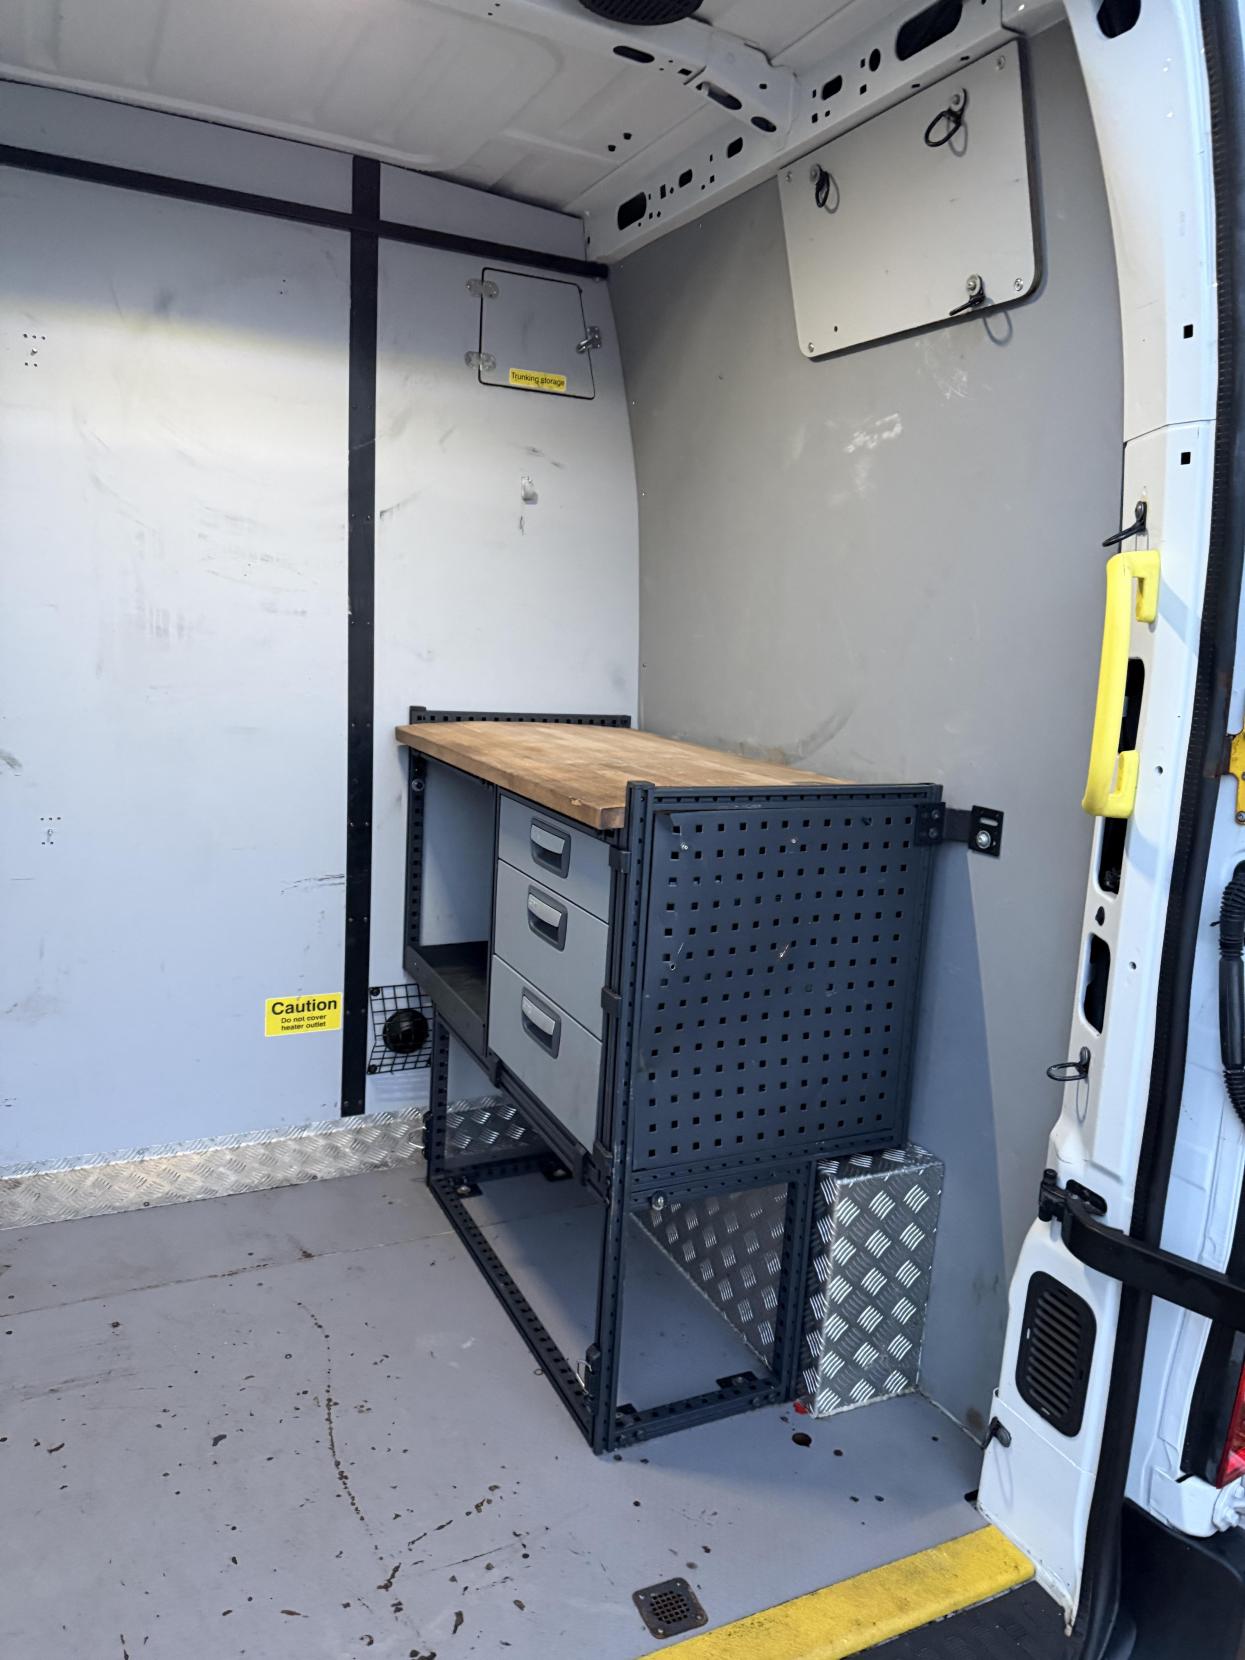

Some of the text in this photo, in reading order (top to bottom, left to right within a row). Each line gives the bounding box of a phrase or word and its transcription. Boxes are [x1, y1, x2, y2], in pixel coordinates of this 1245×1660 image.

[512, 372, 564, 387] Trunking storage
[271, 999, 337, 1015] Caution
